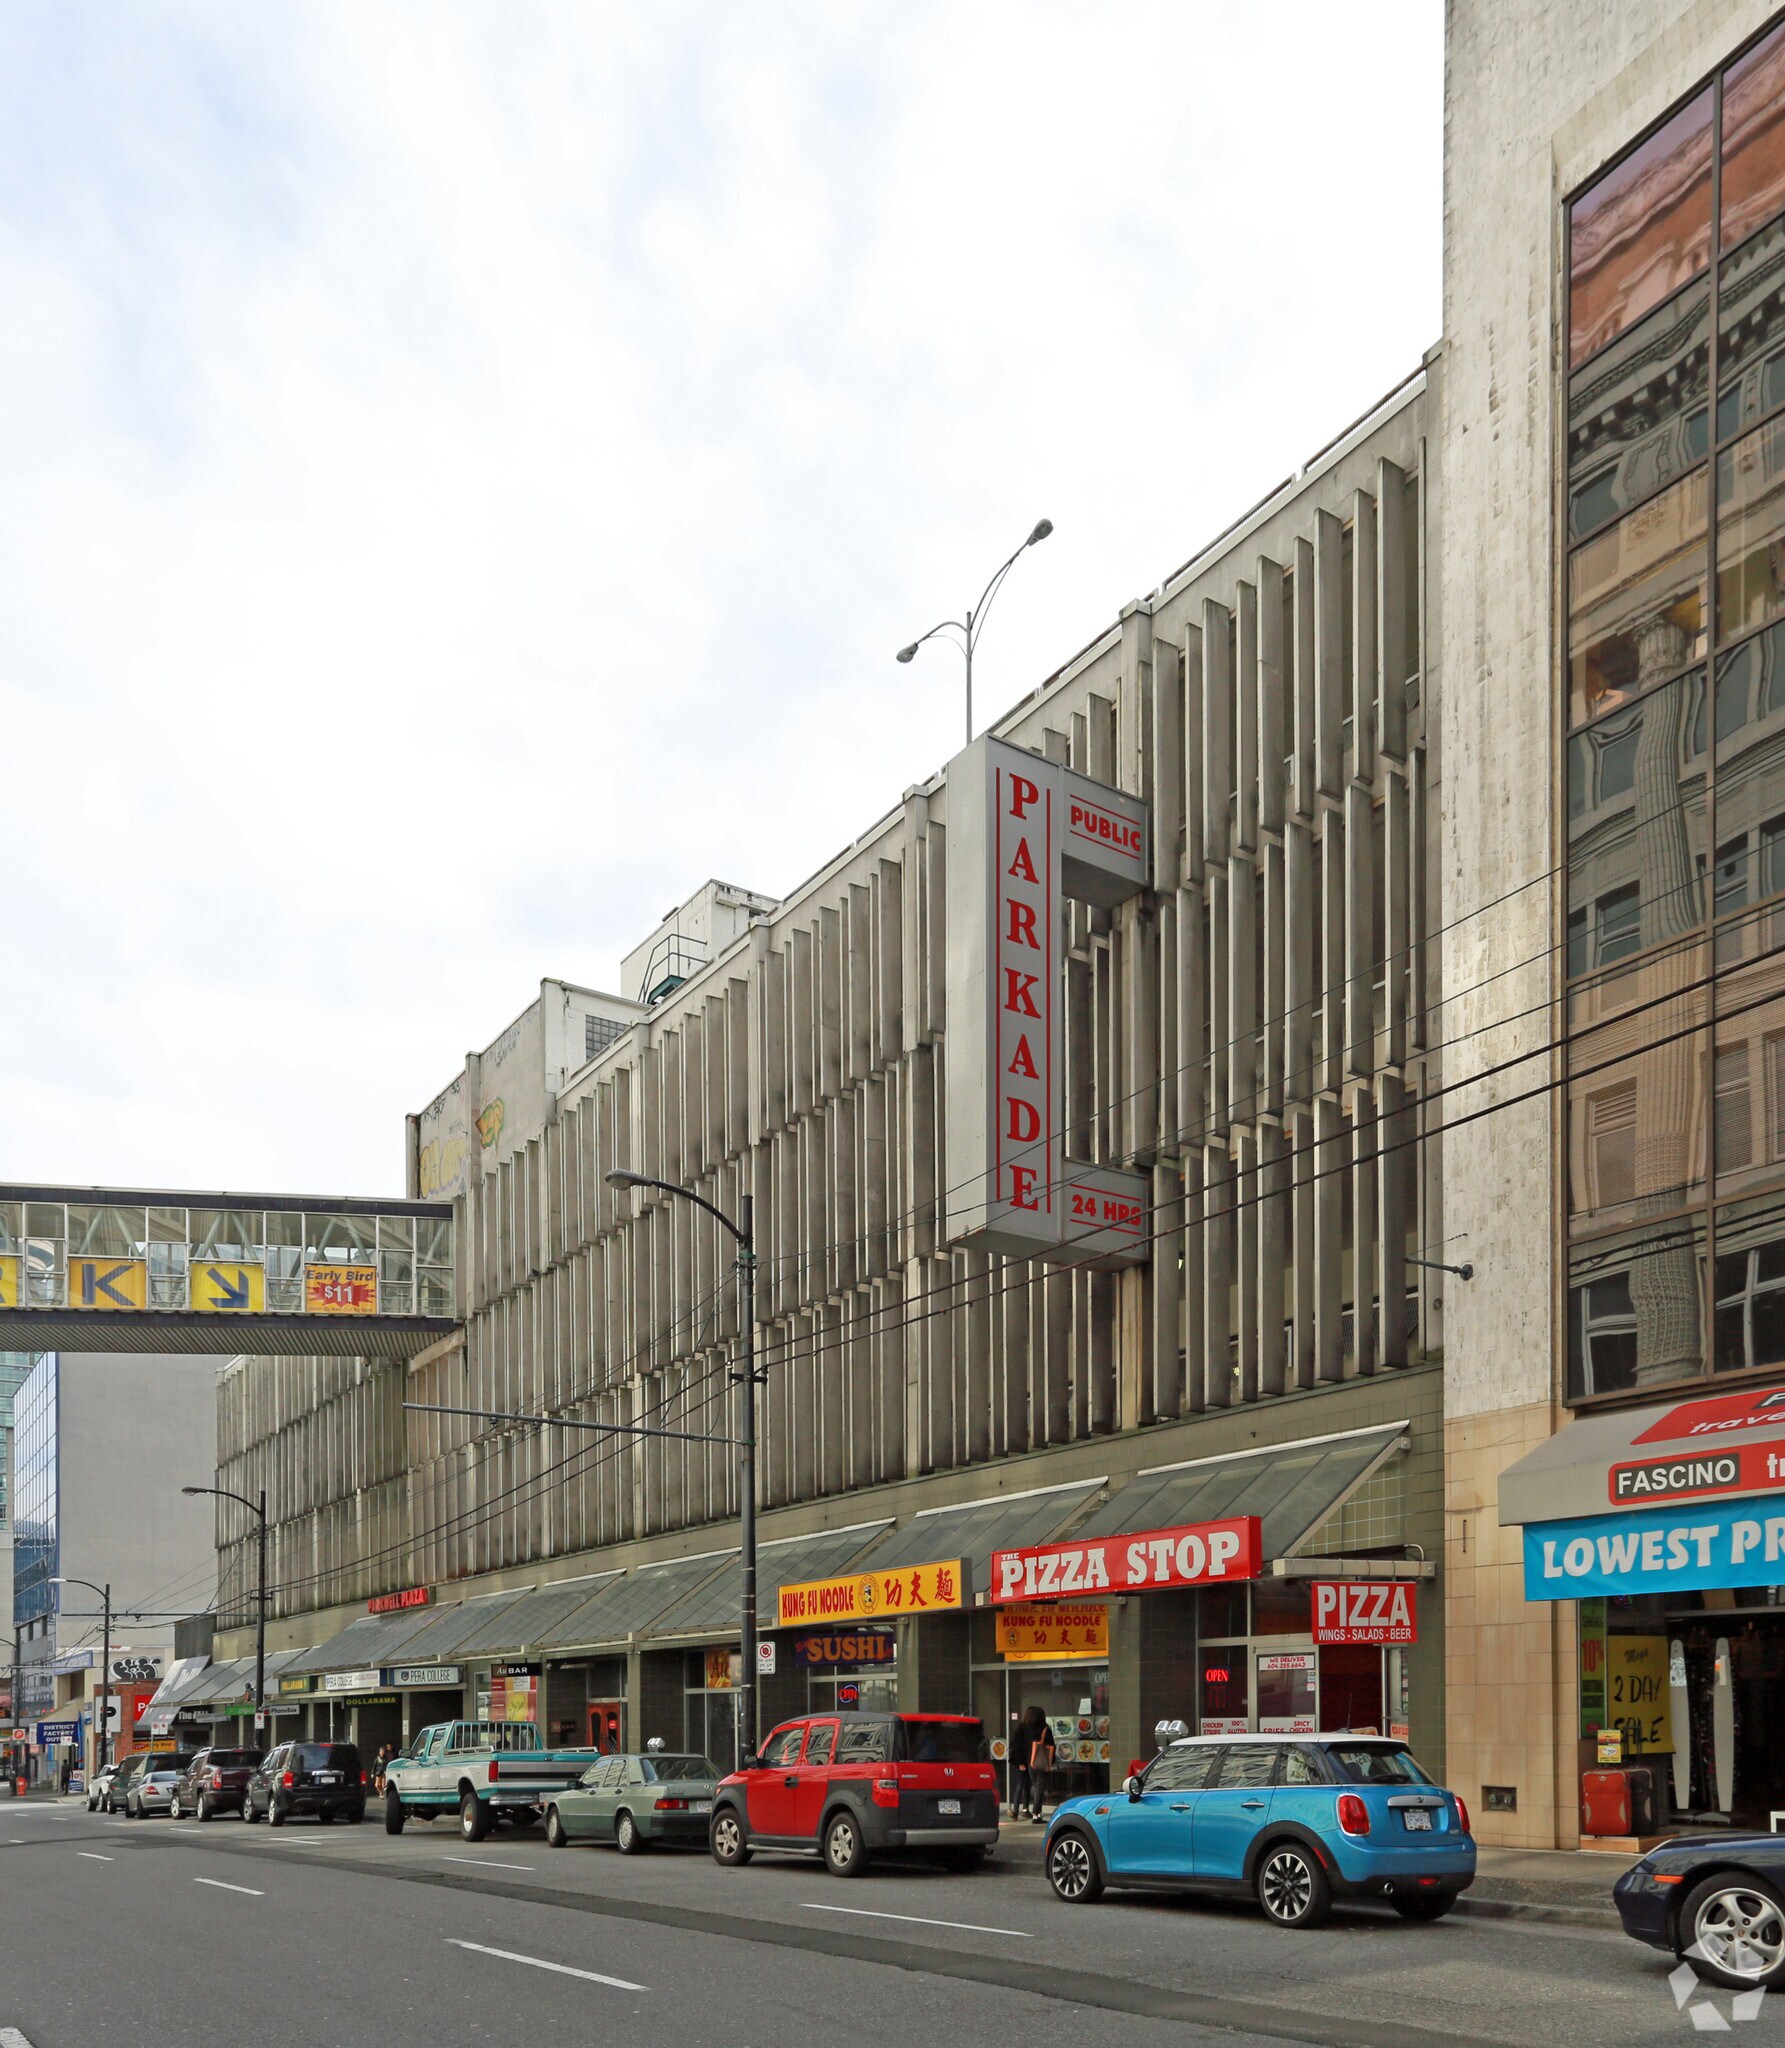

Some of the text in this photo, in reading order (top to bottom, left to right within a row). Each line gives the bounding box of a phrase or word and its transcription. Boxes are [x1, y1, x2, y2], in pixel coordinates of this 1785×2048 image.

[1071, 805, 1141, 852] PUBLIC
[1004, 772, 1041, 1212] PARKADE
[1072, 1194, 1142, 1226] 24 HRS
[306, 1269, 374, 1282] Early Bird
[324, 1285, 352, 1303] $11
[1618, 1458, 1736, 1495] FASCINO
[1001, 1552, 1019, 1561] THE
[1543, 1524, 1720, 1579] LOWEST
[1000, 1531, 1240, 1598] PIZZA STOP
[401, 1588, 424, 1608] PLAZA
[782, 1591, 805, 1618] KUNG
[808, 1589, 817, 1616] FU
[820, 1584, 854, 1614] NOODLE
[1317, 1585, 1411, 1627] PIZZA
[1003, 1615, 1100, 1627] KUNG FU NOODLE
[1318, 1629, 1346, 1641] WINGS
[1352, 1628, 1384, 1640] SALADS
[1390, 1628, 1412, 1640] BEER
[806, 1635, 886, 1662] SUSHI
[410, 1669, 450, 1682] PERA COLLEGE
[1205, 1669, 1229, 1682] OPEN
[346, 1697, 397, 1705] DOLLARAMA
[1613, 1675, 1624, 1703] 2
[1629, 1675, 1663, 1704] DAY
[178, 1711, 192, 1720] The
